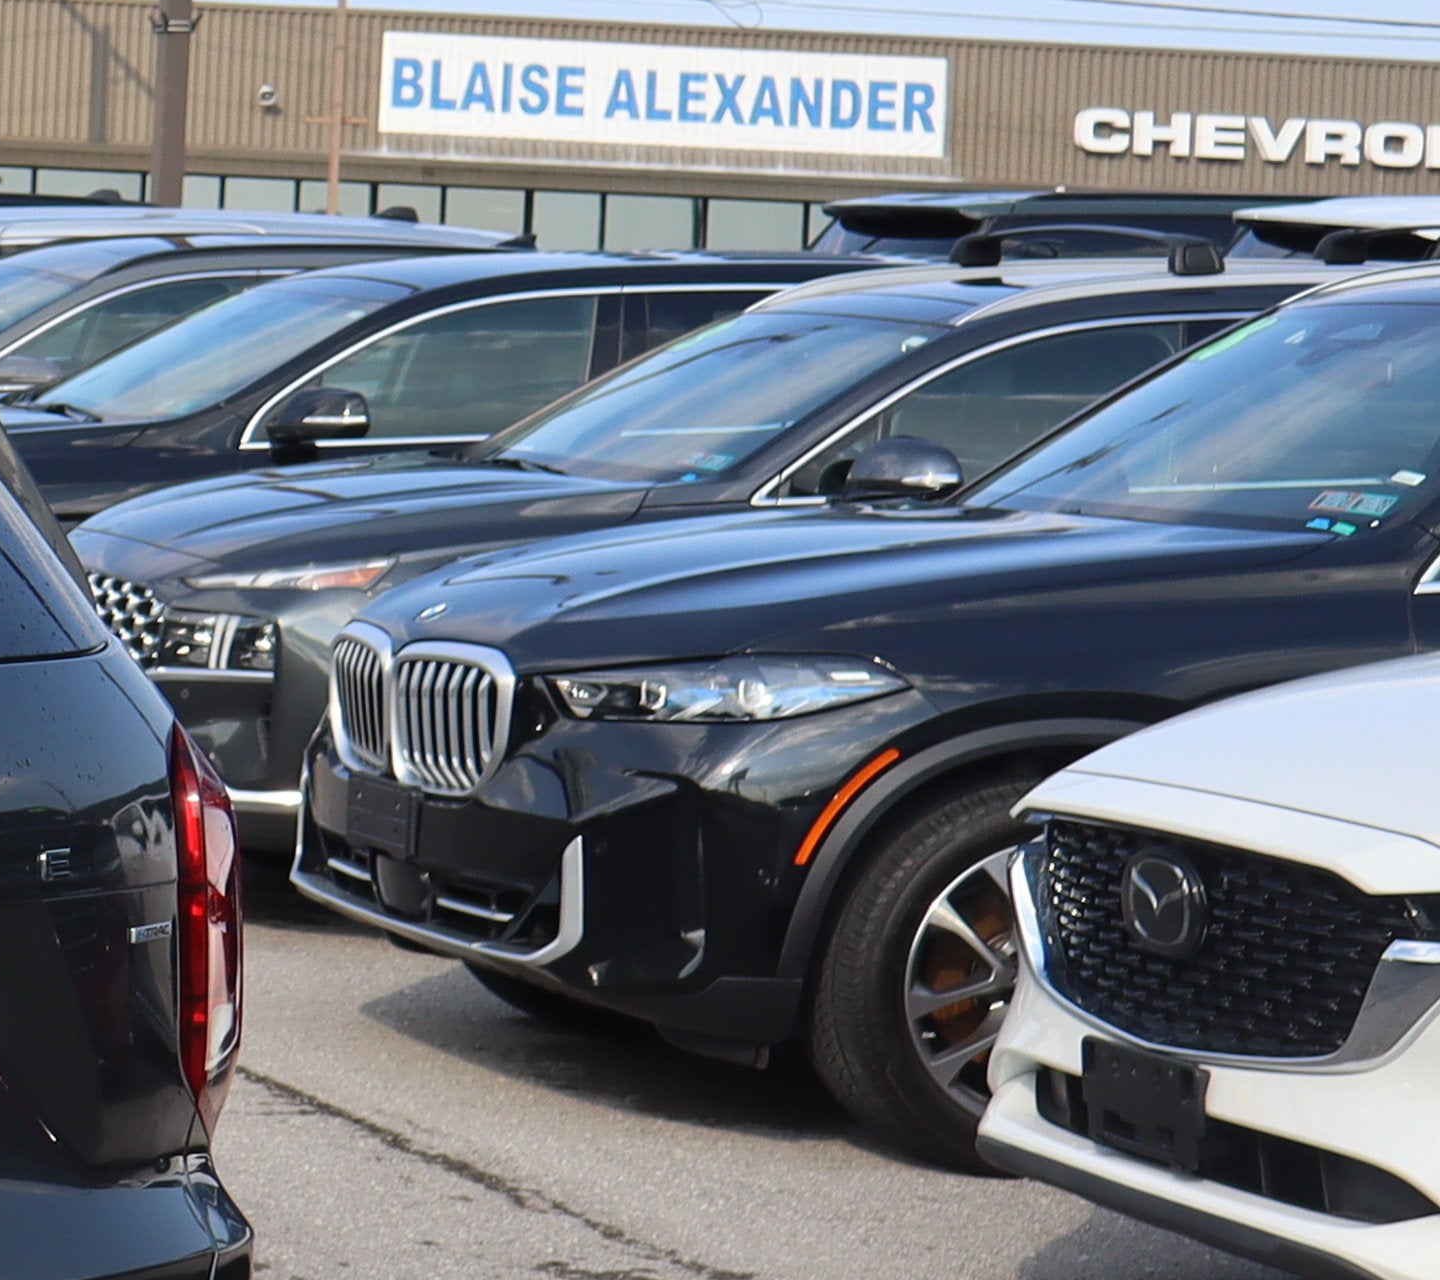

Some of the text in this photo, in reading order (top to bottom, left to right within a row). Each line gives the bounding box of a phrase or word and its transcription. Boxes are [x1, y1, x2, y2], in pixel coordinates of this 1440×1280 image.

[391, 58, 936, 133] BLAISE ALEXANDER
[1074, 107, 1440, 169] CHEVRO
